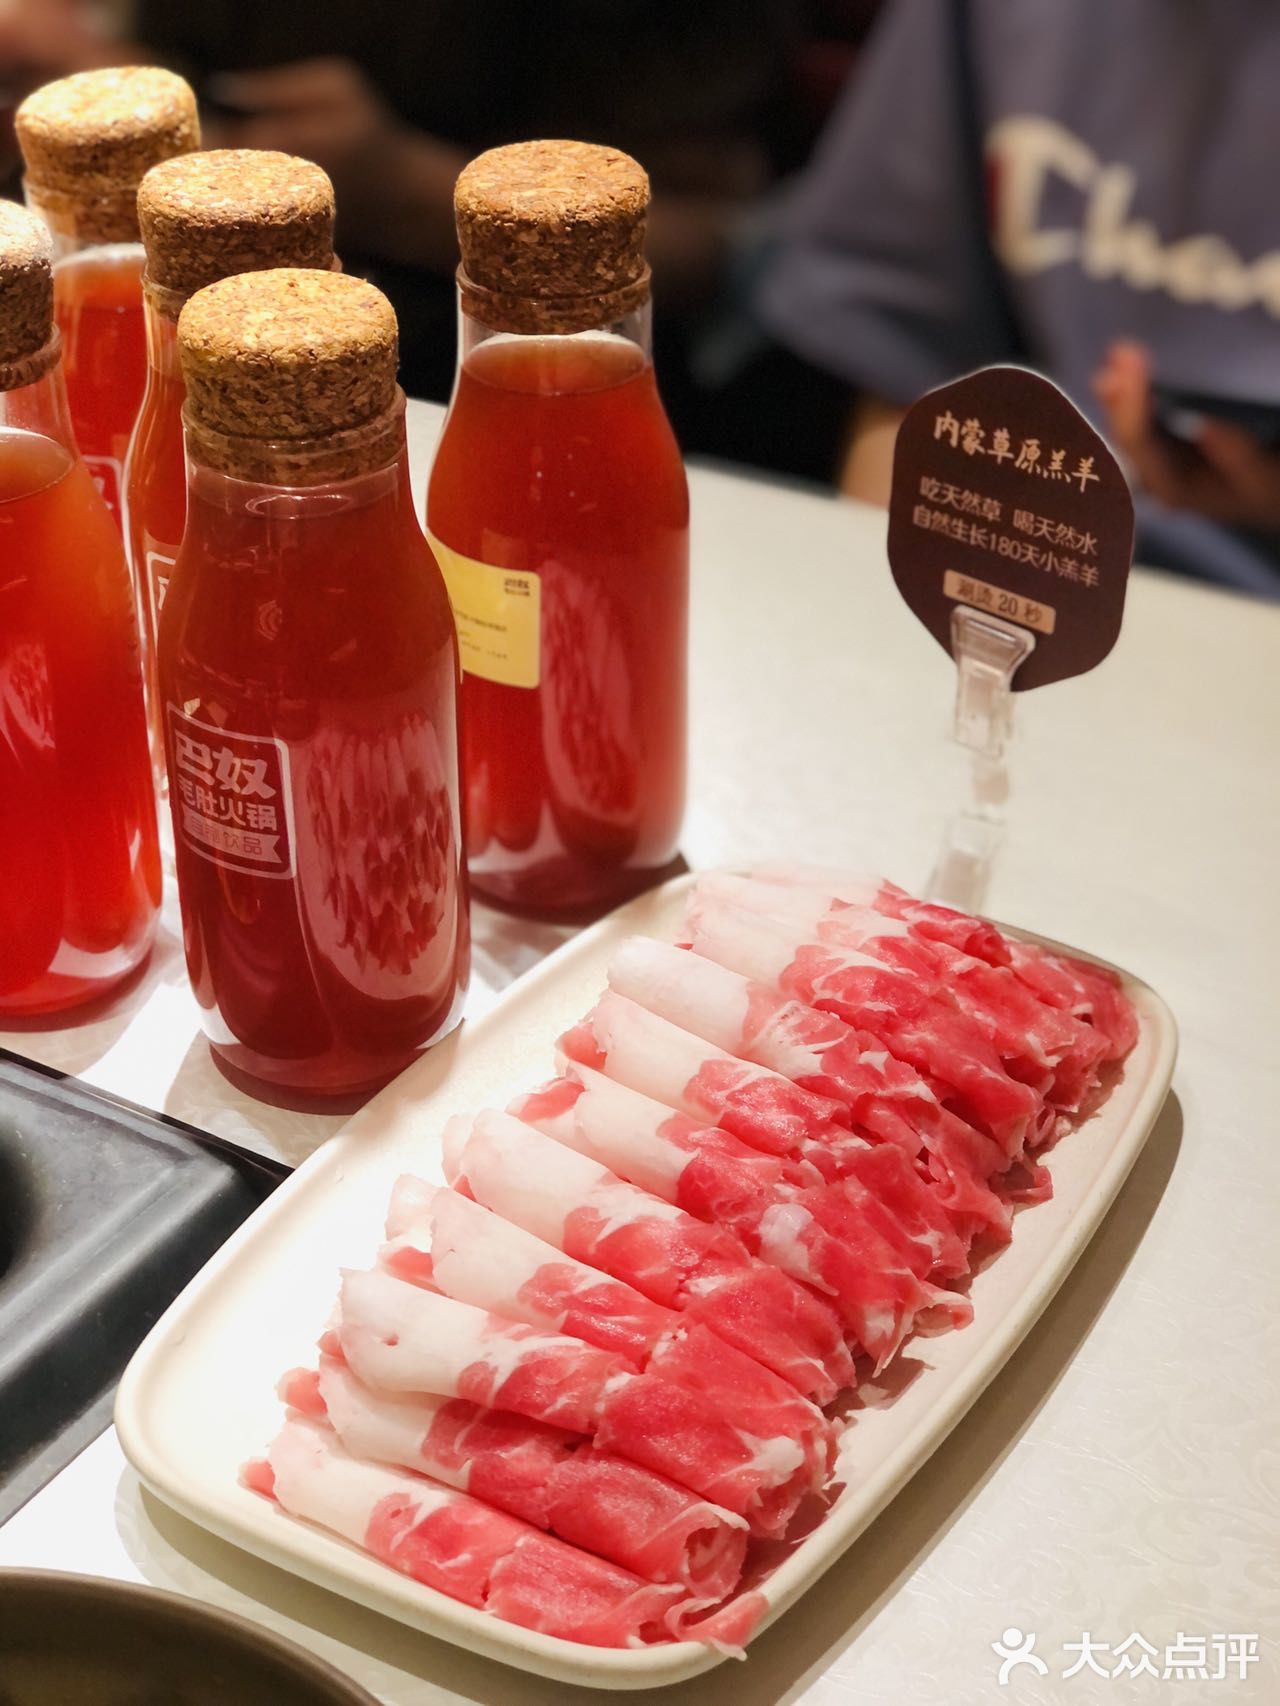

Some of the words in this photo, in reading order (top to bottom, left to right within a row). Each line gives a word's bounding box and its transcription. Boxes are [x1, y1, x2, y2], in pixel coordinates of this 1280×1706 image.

[933, 410, 1100, 493] 内蒙草原羔羊
[912, 504, 1100, 588] 自然生长180天小羔羊
[920, 476, 1002, 522] 吃天然草
[1013, 509, 1098, 556] 喝天然水
[998, 593, 1018, 617] 20
[1024, 602, 1043, 623] 秒
[174, 728, 277, 800] 巴奴
[177, 773, 278, 832] 毛肚火锅
